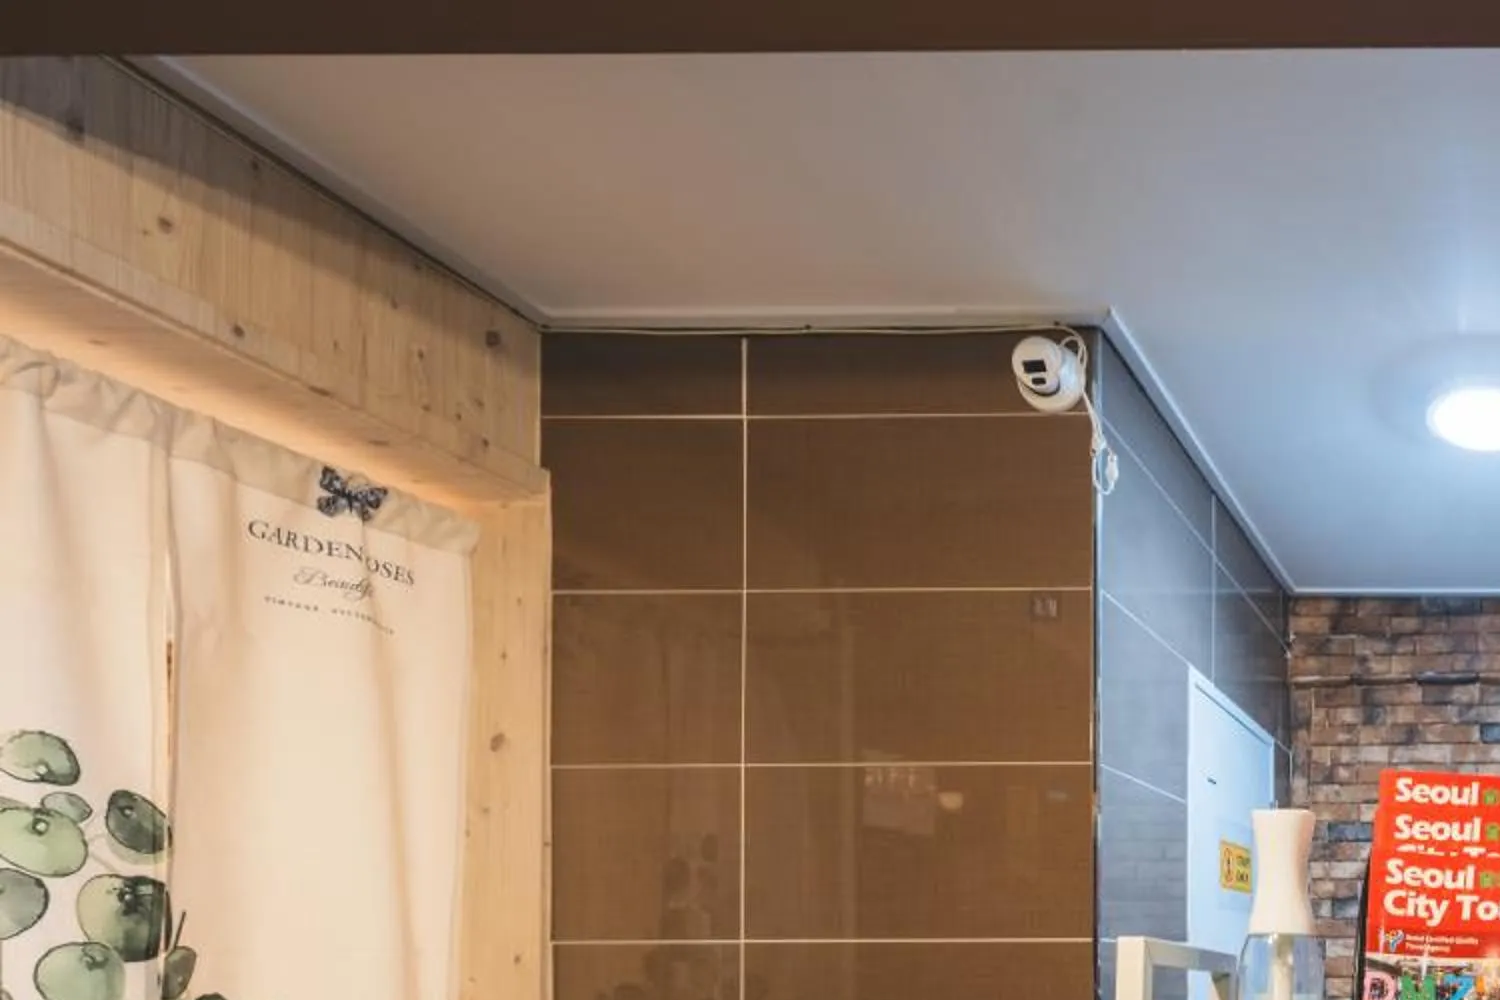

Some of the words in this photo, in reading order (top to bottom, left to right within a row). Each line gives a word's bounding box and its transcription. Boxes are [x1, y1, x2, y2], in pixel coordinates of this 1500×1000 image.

[1395, 777, 1480, 806] Seoul
[1394, 814, 1481, 842] Seoul
[1385, 858, 1475, 889] Seoul
[1384, 890, 1449, 926] City
